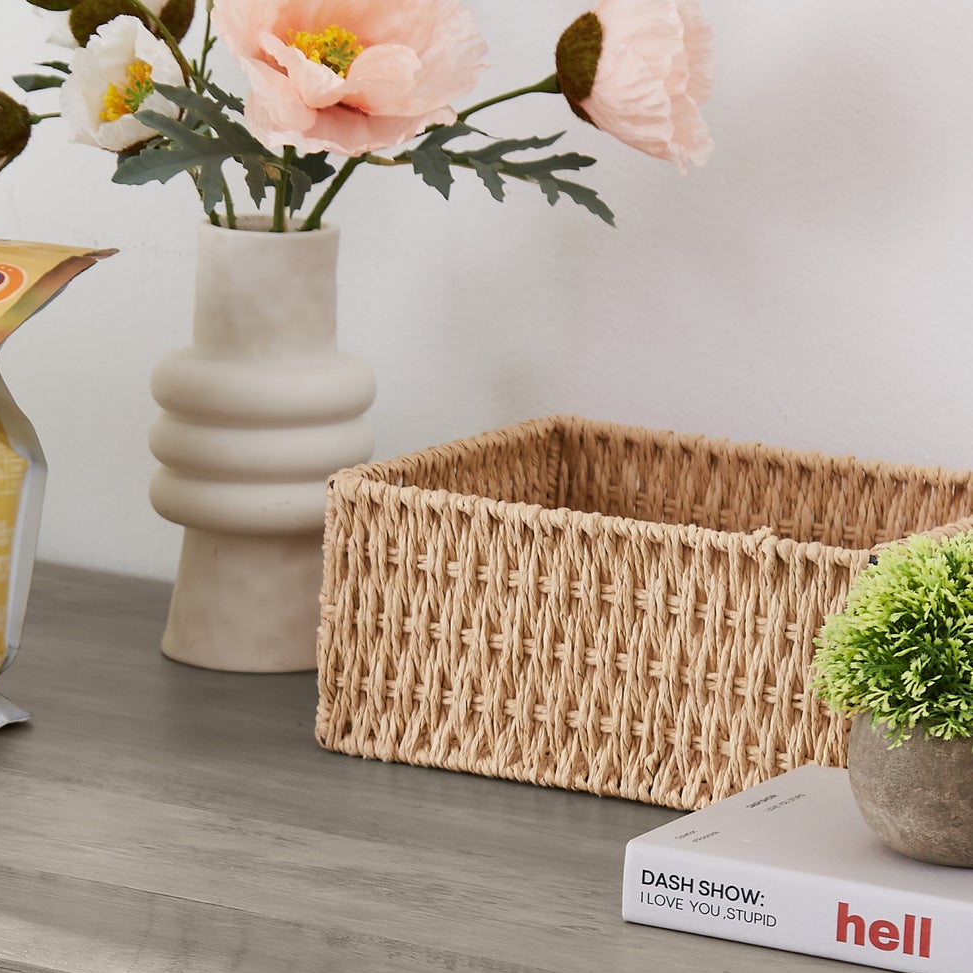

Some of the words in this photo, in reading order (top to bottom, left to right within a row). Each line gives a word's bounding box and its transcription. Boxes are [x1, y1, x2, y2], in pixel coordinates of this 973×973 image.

[639, 891, 644, 904] I
[647, 893, 685, 911] LOVE
[689, 900, 721, 918] YOU
[641, 869, 694, 894] DASH
[698, 880, 766, 907] SHOW:
[836, 901, 933, 959] hell
